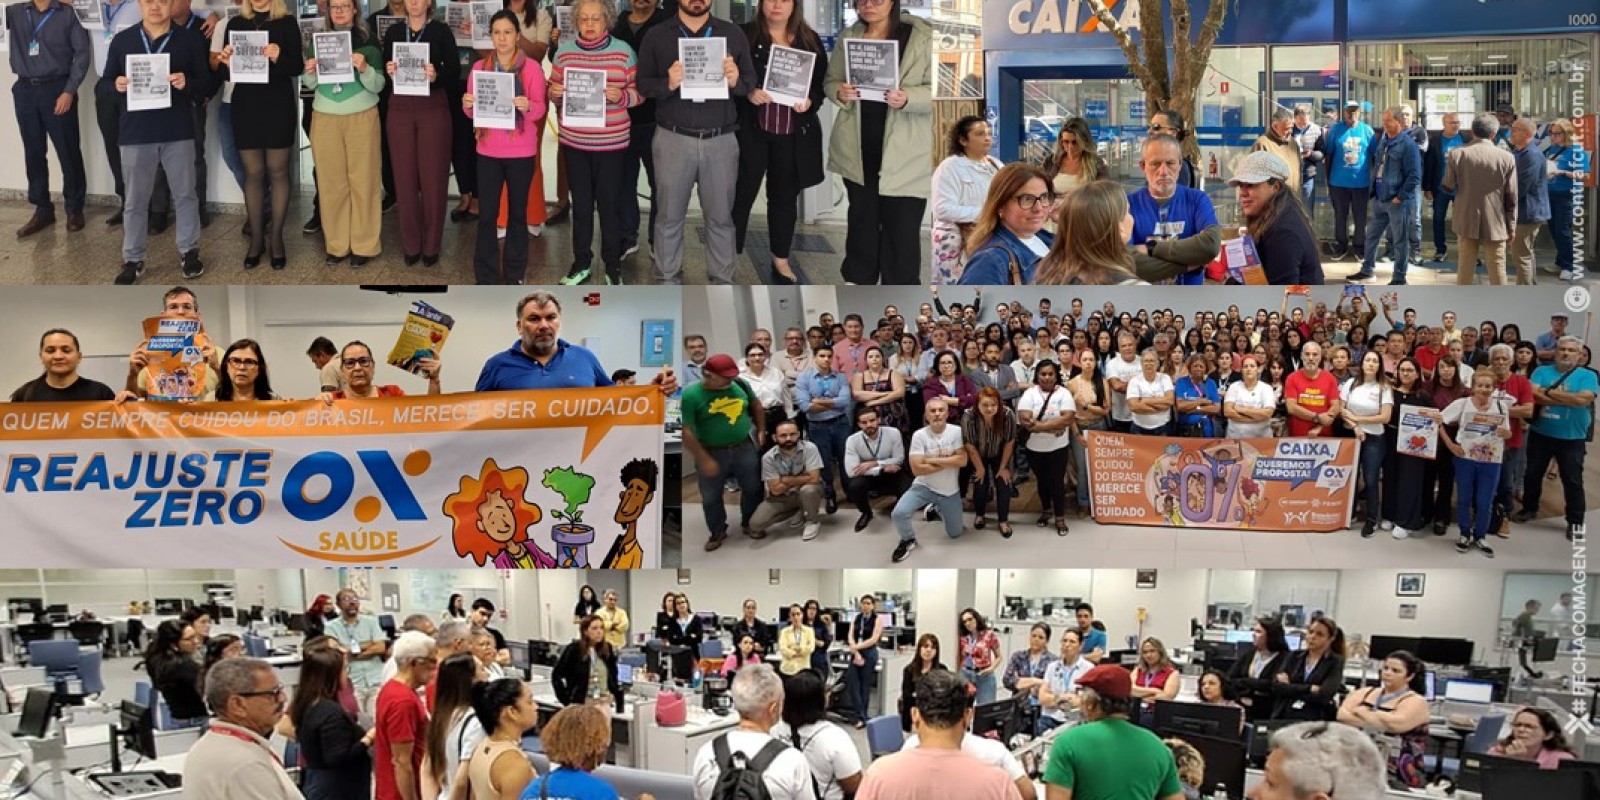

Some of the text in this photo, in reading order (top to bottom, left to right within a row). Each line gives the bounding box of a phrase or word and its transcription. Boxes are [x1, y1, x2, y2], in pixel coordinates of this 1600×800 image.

[1009, 0, 1141, 34] CAIXA
[1568, 13, 1597, 25] 1000
[3, 397, 655, 430] QUEM SEMPRE CUIDOU DO BRASIL, MERECE SER CUIDADO.
[1095, 436, 1125, 446] QUEM
[1095, 447, 1135, 458] SEMPRE
[1280, 442, 1334, 458] CAIXA,
[1095, 459, 1134, 470] CUIDOU
[1256, 460, 1312, 470] QUEREMOS
[3, 449, 273, 493] REAJUSTE
[1095, 471, 1145, 482] DO BRASIL
[1256, 468, 1312, 477] PROPOSTA!
[1095, 483, 1141, 493] MERECE
[1095, 494, 1116, 505] SER
[125, 490, 265, 528] ZERO
[1096, 506, 1146, 517] CUIDADO
[318, 527, 398, 551] SAÚDE
